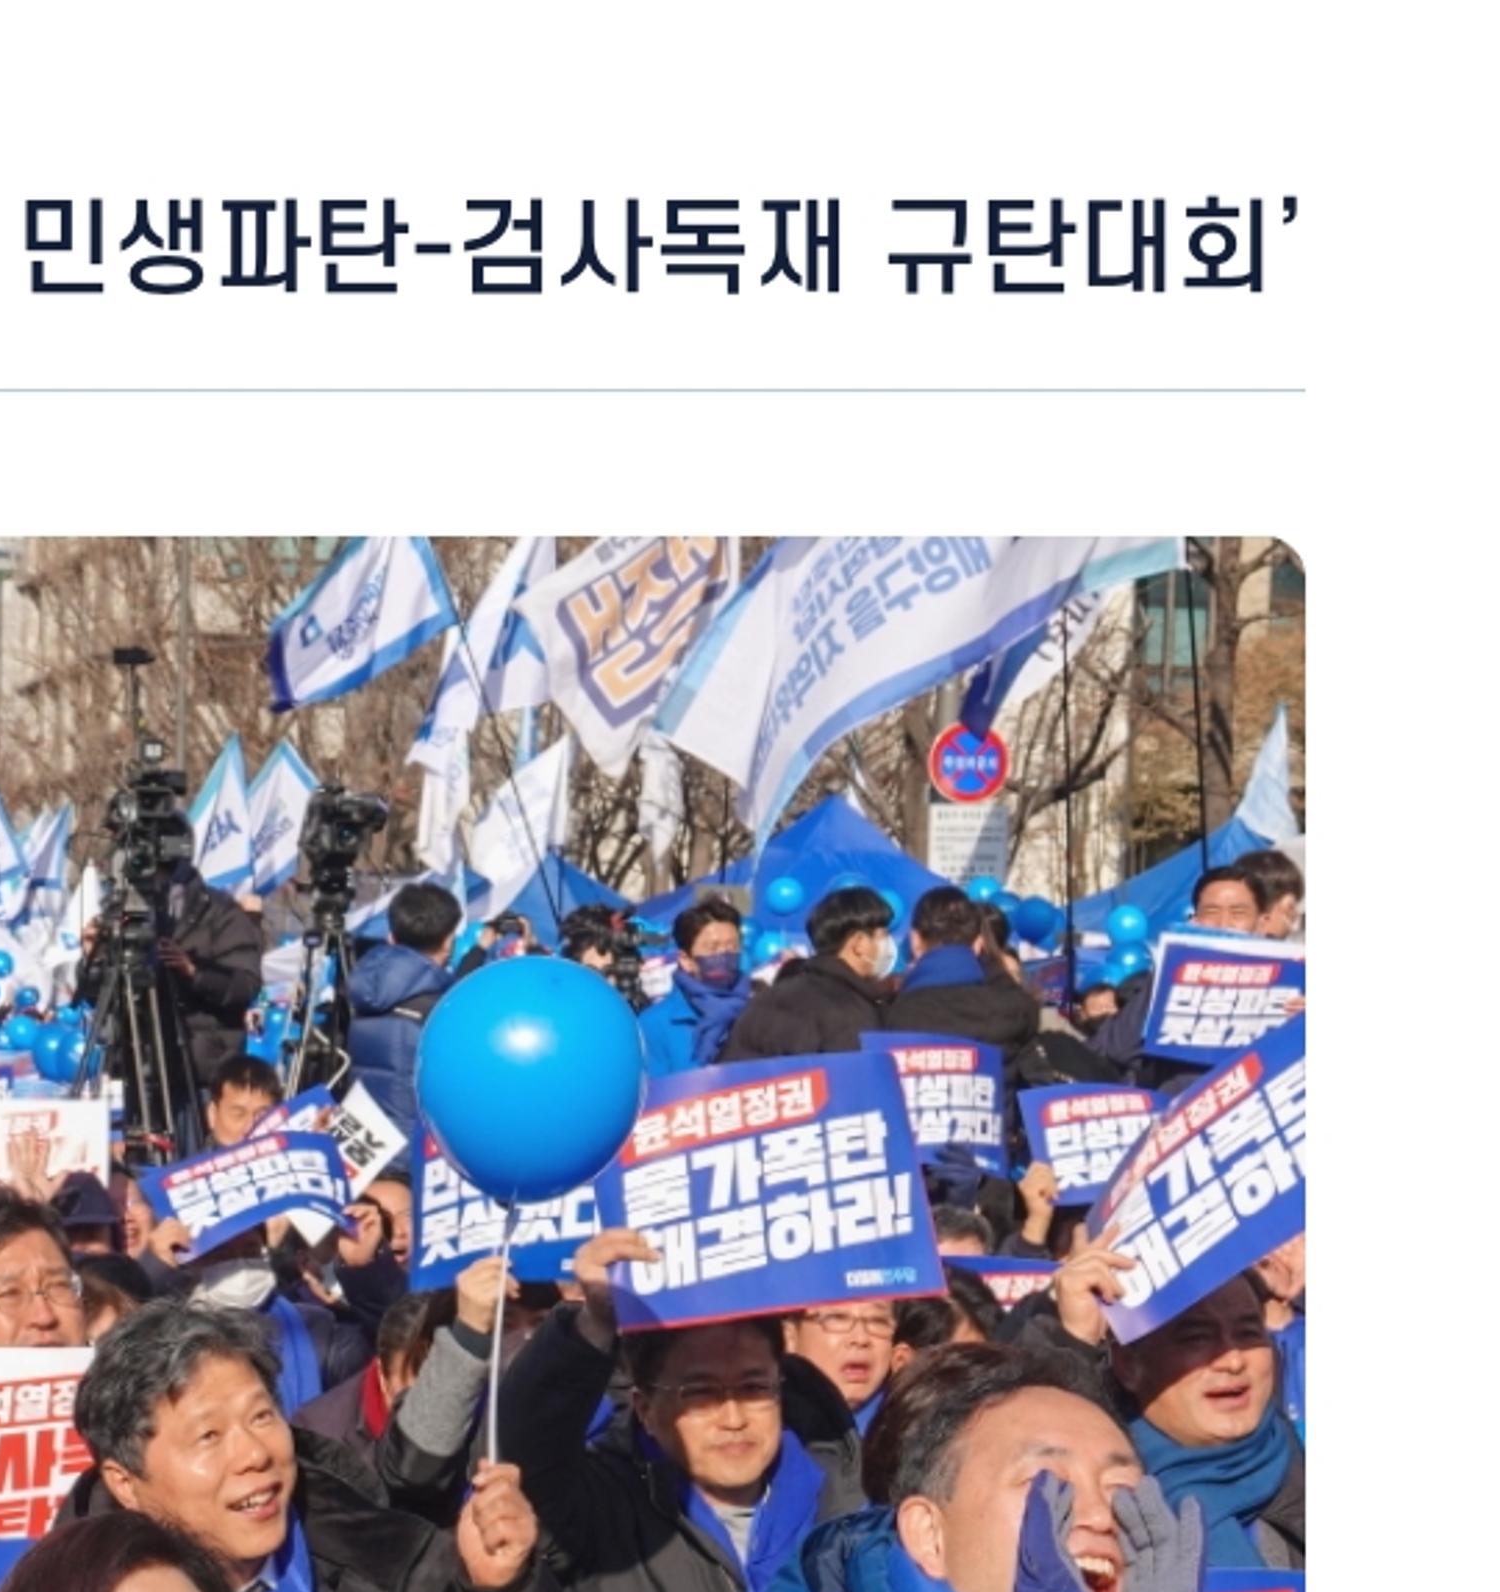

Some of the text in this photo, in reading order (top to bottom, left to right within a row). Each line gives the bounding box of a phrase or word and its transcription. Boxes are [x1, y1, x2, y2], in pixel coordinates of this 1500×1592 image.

[622, 1110, 888, 1230] 물가폭탄
[632, 1077, 816, 1158] 윤석열정권
[628, 1172, 915, 1297] 해결하라!
